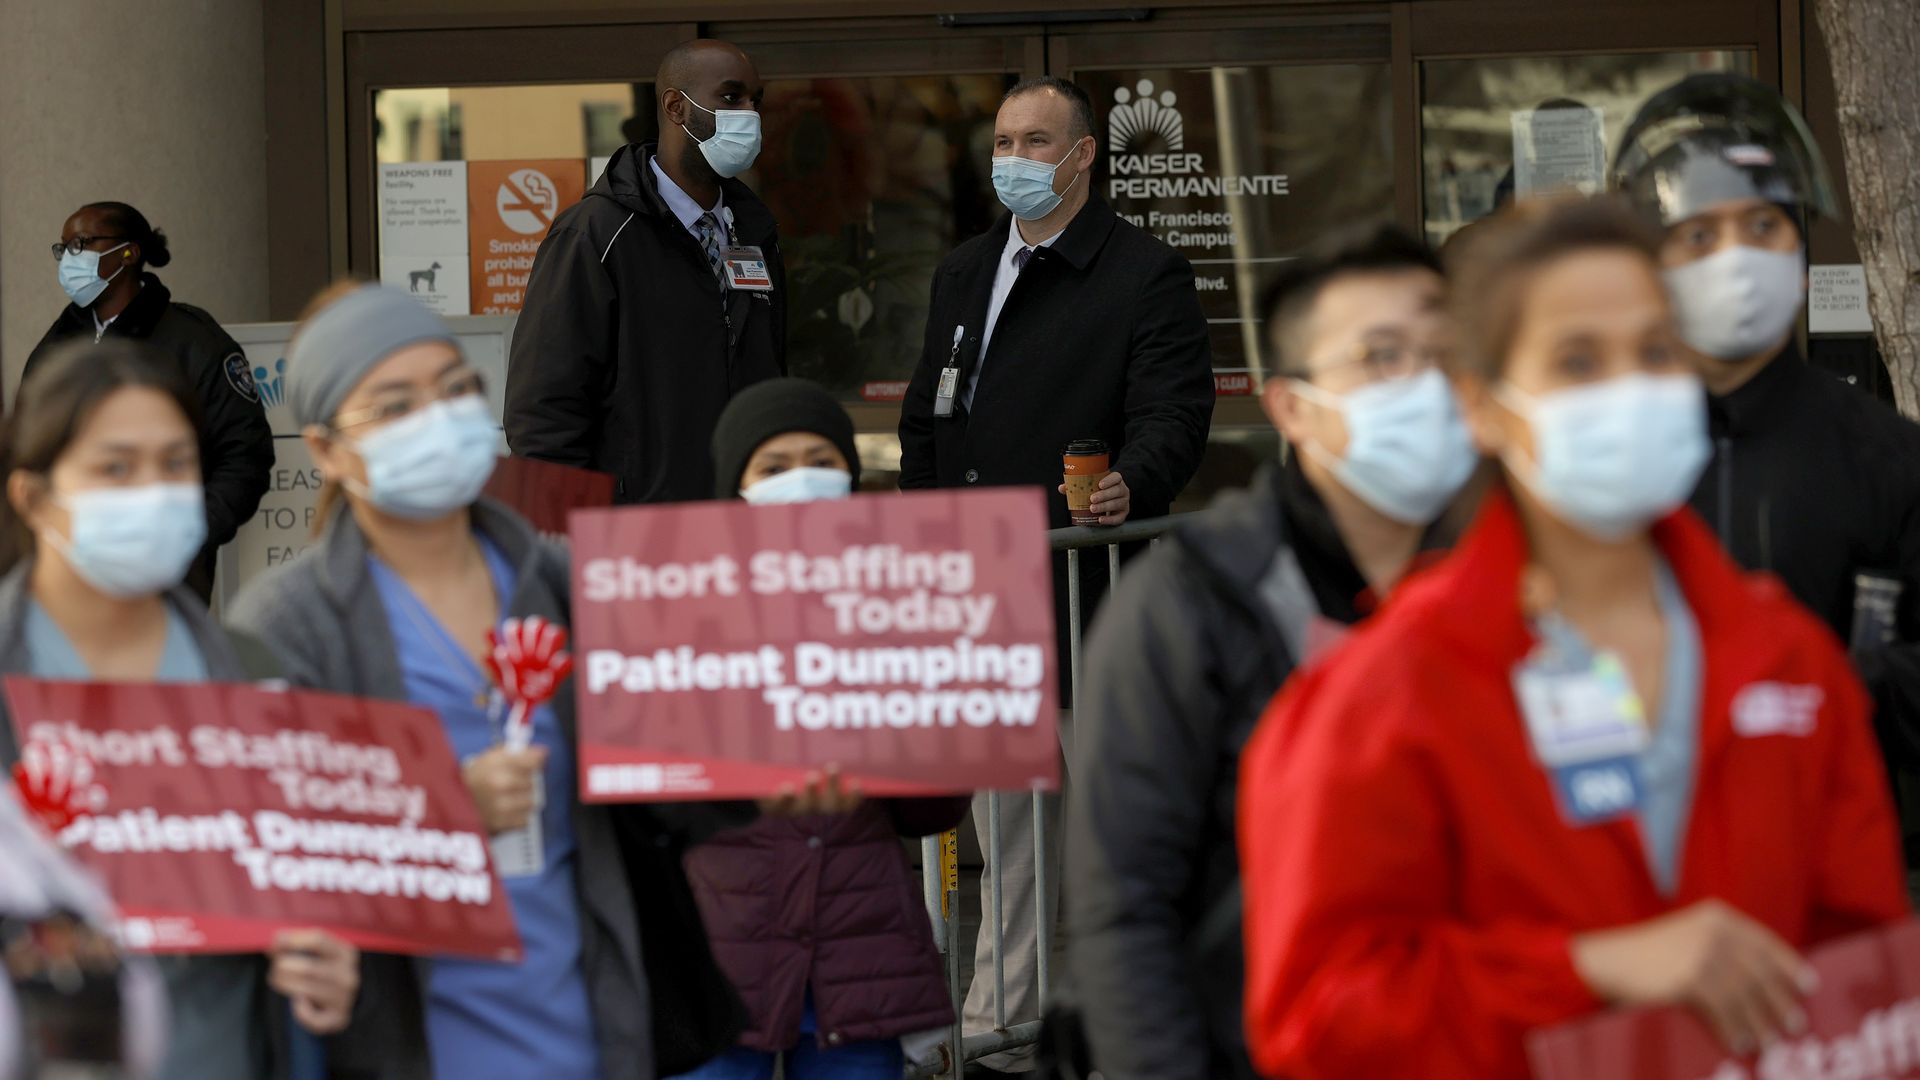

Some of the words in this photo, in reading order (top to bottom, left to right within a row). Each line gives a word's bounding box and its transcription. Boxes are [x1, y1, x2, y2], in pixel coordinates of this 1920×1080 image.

[385, 169, 430, 178] WEAPONS
[432, 168, 454, 178] FREE
[1109, 153, 1204, 175] KAISER
[1109, 174, 1289, 199] PERMANENTE
[1148, 210, 1234, 228] Francisco
[1166, 230, 1238, 250] Campus
[487, 272, 505, 288] all
[492, 289, 521, 304] and
[1195, 277, 1228, 291] Blvd.
[260, 506, 296, 530] TO
[582, 552, 740, 602] Short
[749, 544, 974, 595] Staffing
[823, 590, 996, 637] Today
[586, 644, 787, 693] Patient
[793, 637, 1045, 689] Dumping
[763, 685, 1043, 732] Tomorrow
[189, 724, 402, 785] Staffing
[267, 769, 427, 824] Today
[252, 808, 487, 873] Dumping
[233, 847, 492, 905] Tomorrow
[1757, 1002, 1920, 1080] Staff
